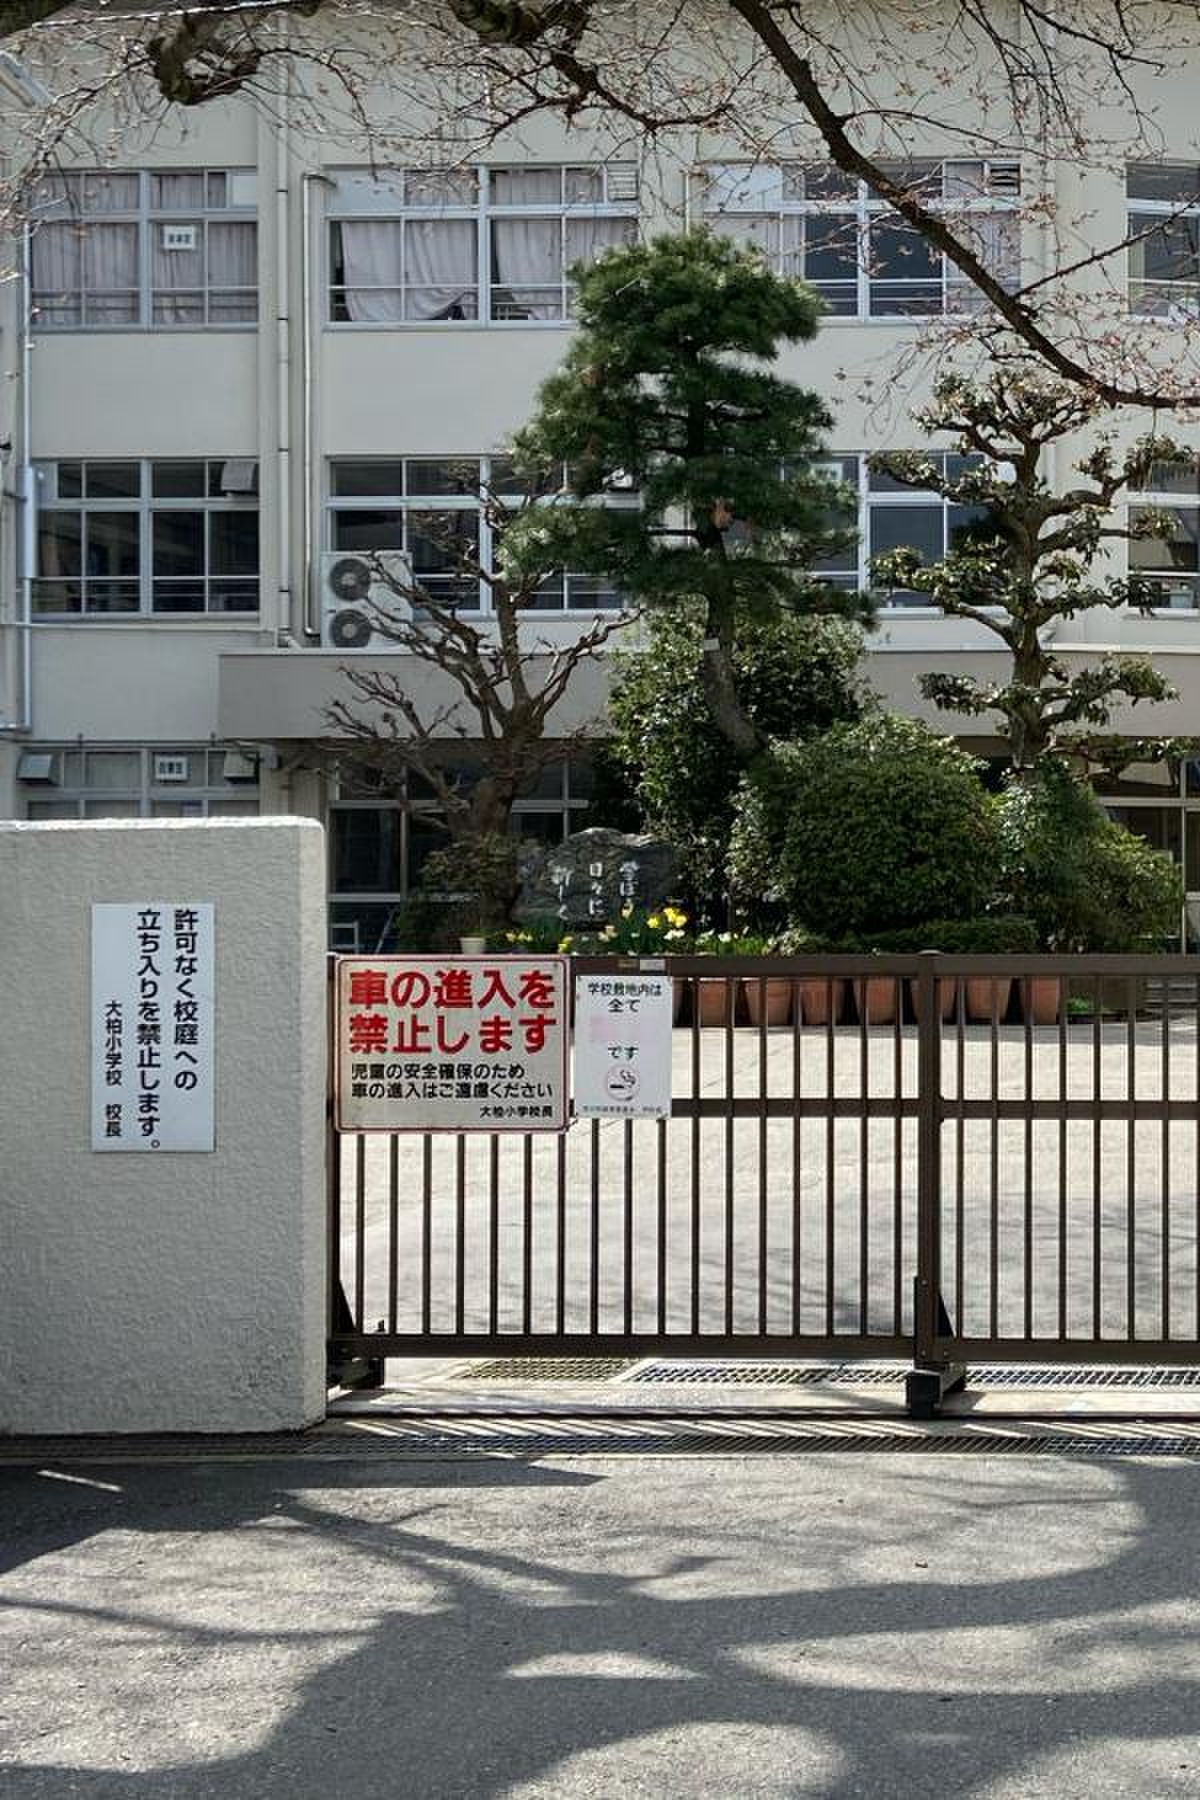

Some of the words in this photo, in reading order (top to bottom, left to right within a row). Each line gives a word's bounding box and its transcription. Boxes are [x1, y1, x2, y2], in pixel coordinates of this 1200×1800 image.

[173, 908, 199, 1091] 許可なく校庭への
[350, 969, 556, 1010] 車の進入を
[587, 981, 663, 997] 学校敷地内は
[608, 998, 641, 1013] 全て
[105, 1000, 123, 1086] 大柏小学校
[137, 908, 162, 1149] 立ち入りを禁止します。
[350, 1013, 557, 1055] 禁止します
[607, 1045, 640, 1060] です
[351, 1062, 526, 1081] 児童の安全確保のため
[351, 1081, 553, 1099] 車の進入はご遠慮ください
[105, 1103, 123, 1138] 校長
